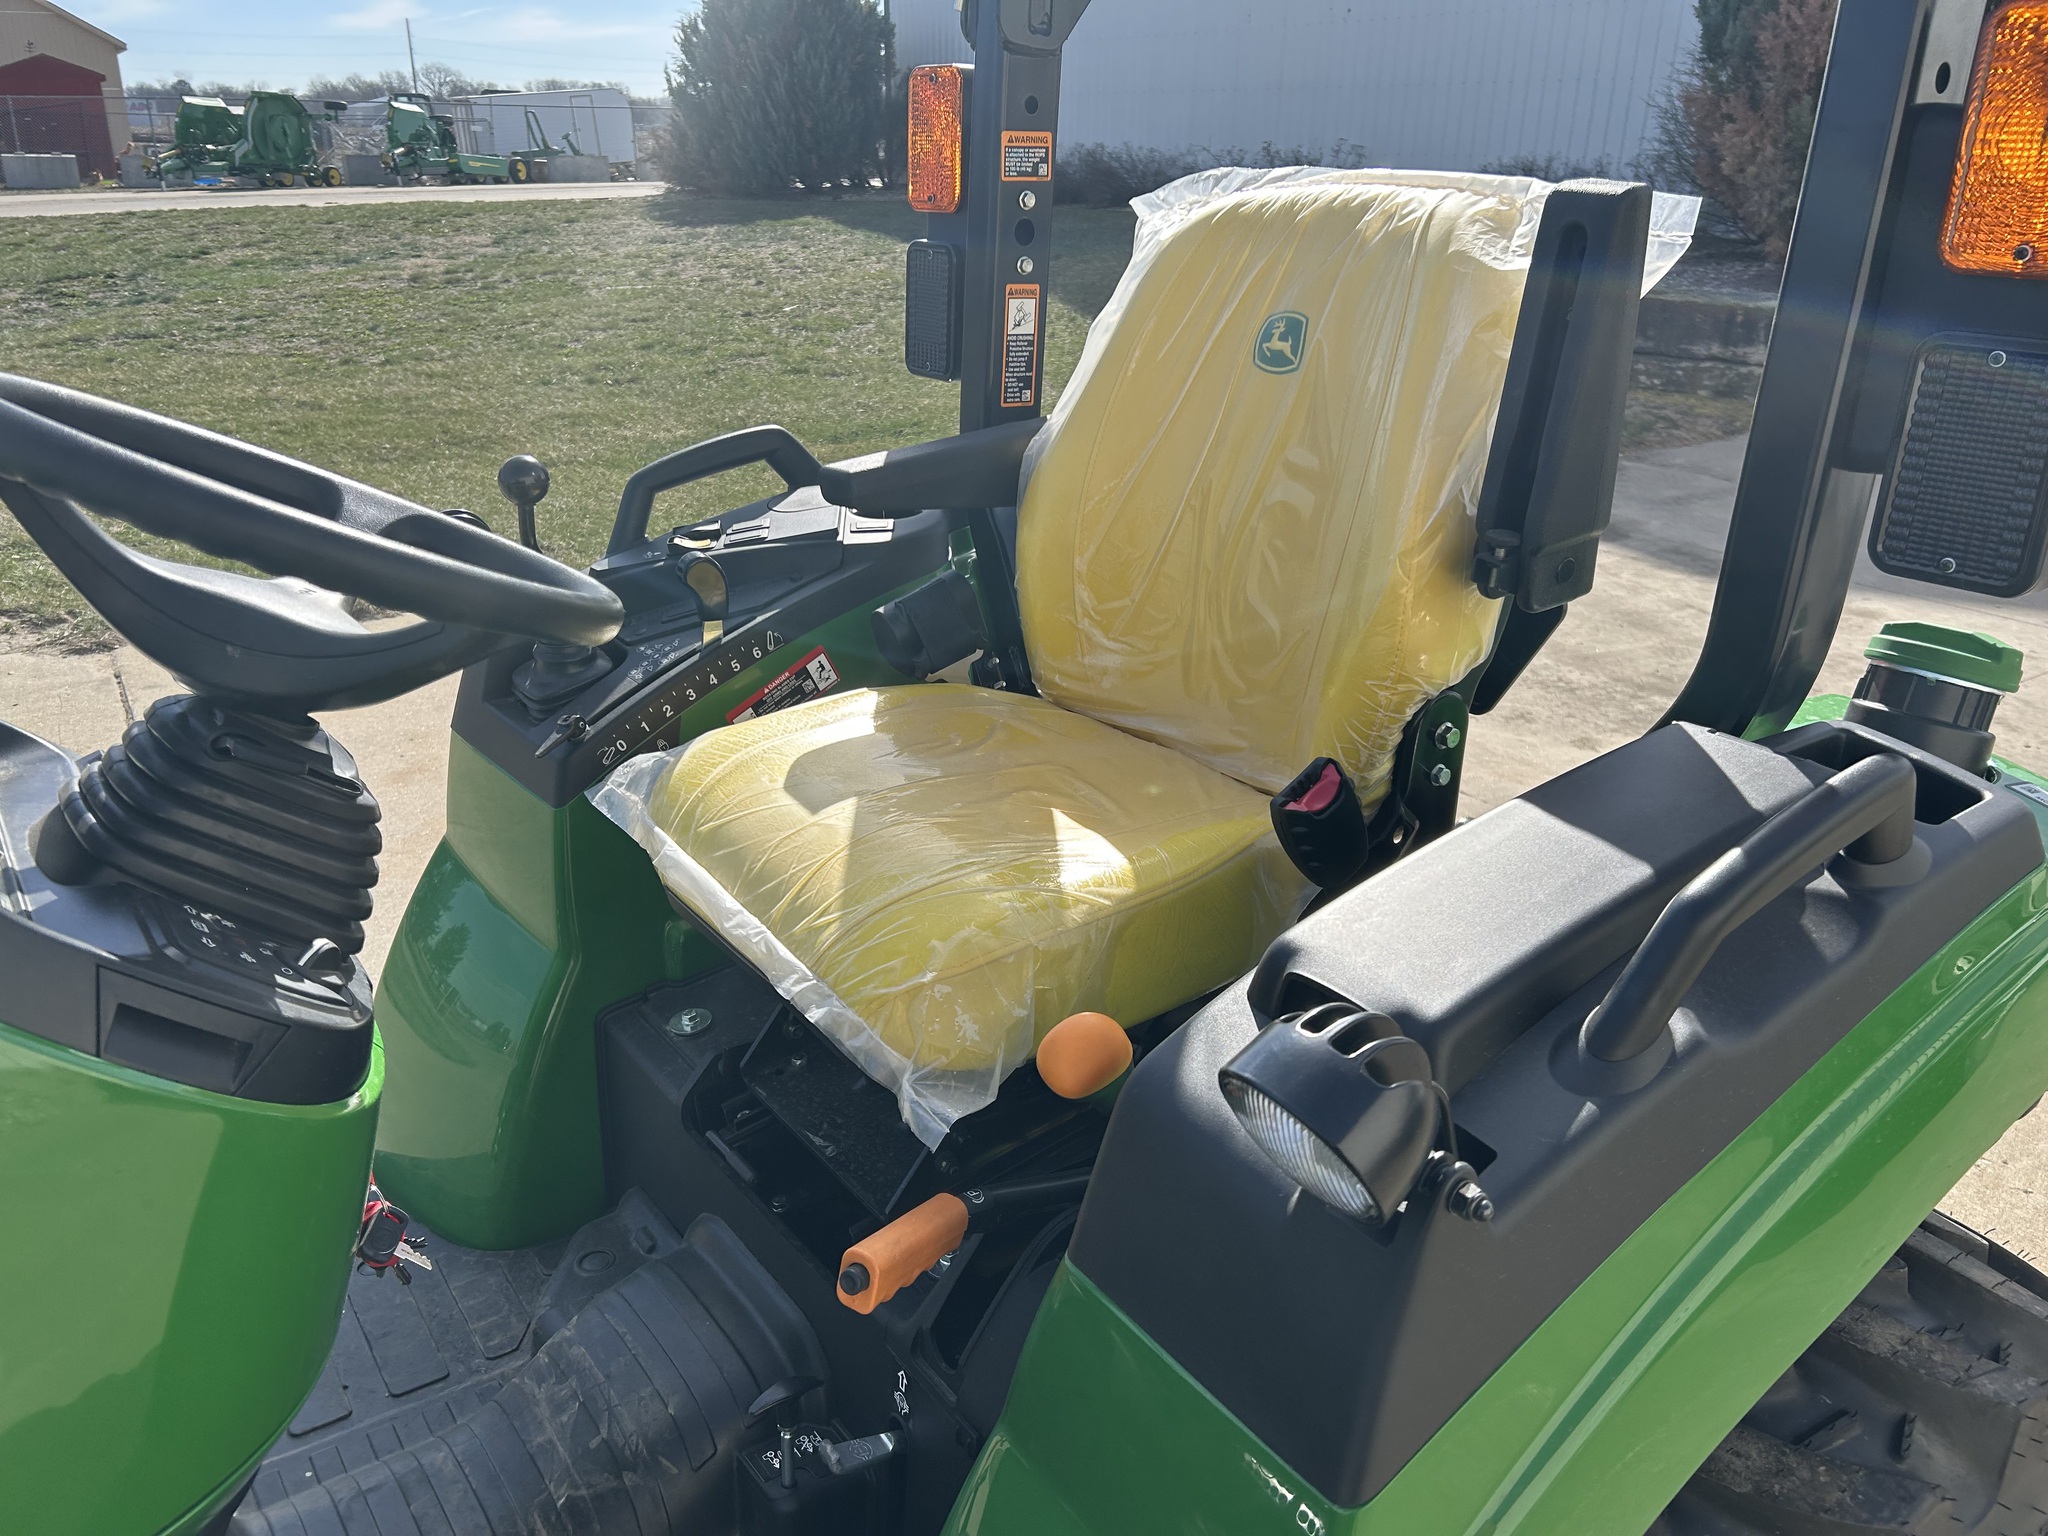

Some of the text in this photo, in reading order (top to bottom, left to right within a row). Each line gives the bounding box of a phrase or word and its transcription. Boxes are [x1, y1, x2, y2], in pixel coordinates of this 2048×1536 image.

[1014, 136, 1048, 144] WARNING
[768, 672, 790, 690] DANGER
[616, 647, 762, 752] 0 1 2 3 4 5 6
